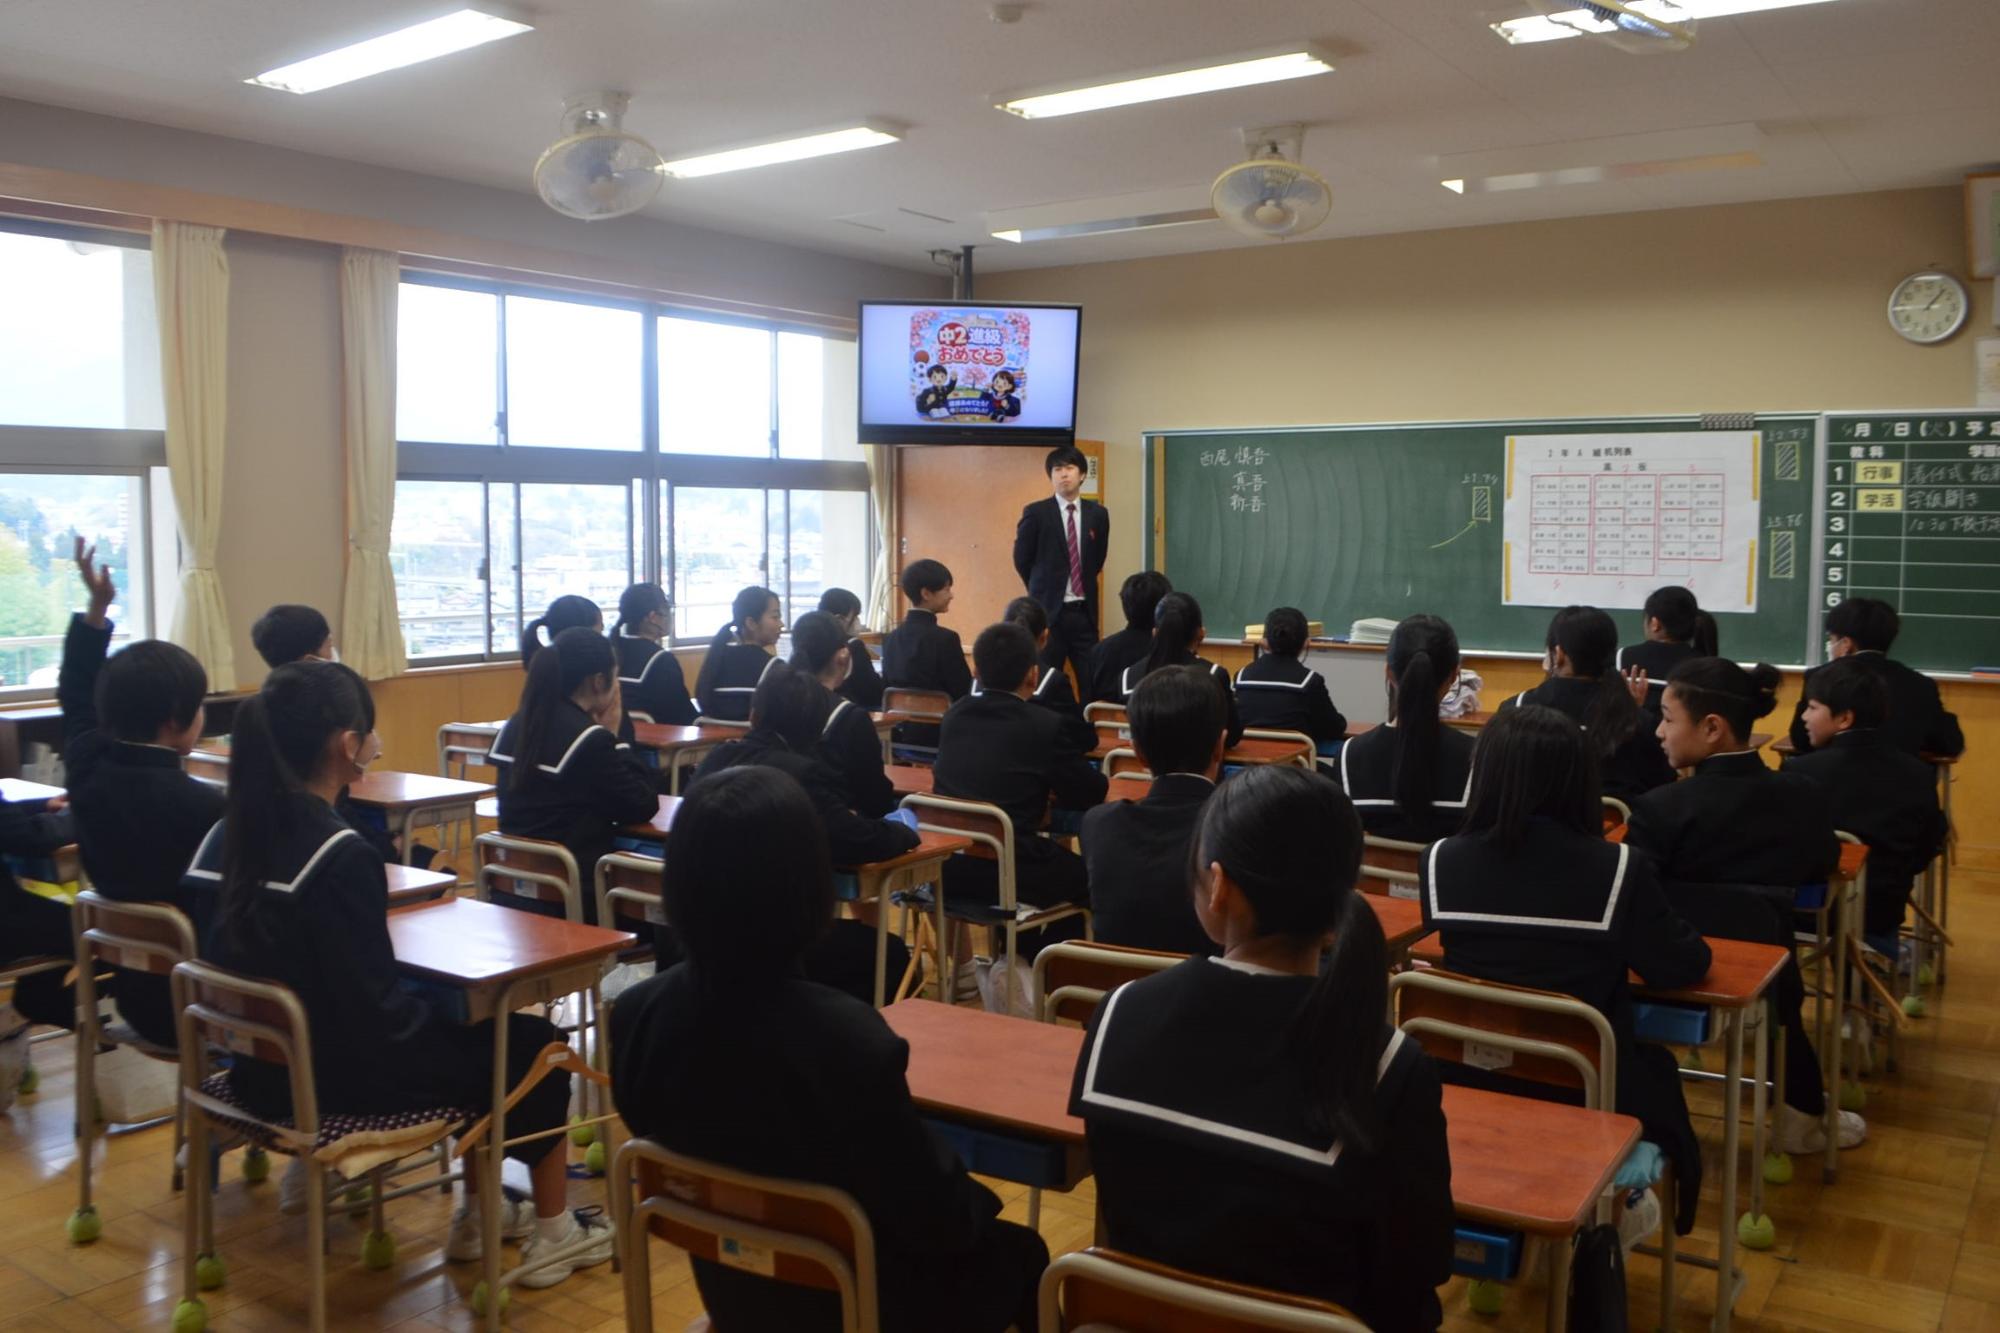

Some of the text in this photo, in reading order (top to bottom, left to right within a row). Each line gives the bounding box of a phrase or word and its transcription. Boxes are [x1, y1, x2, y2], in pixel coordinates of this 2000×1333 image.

[938, 346, 1006, 366] おめでとう
[1833, 466, 1843, 482] 1
[1863, 465, 1894, 480] 行事
[1831, 491, 1846, 507] 2
[1864, 493, 1895, 507] 学活
[1829, 516, 1845, 532] 3
[1828, 542, 1844, 557] 4
[1827, 567, 1843, 582] 5
[1826, 592, 1842, 607] 6
